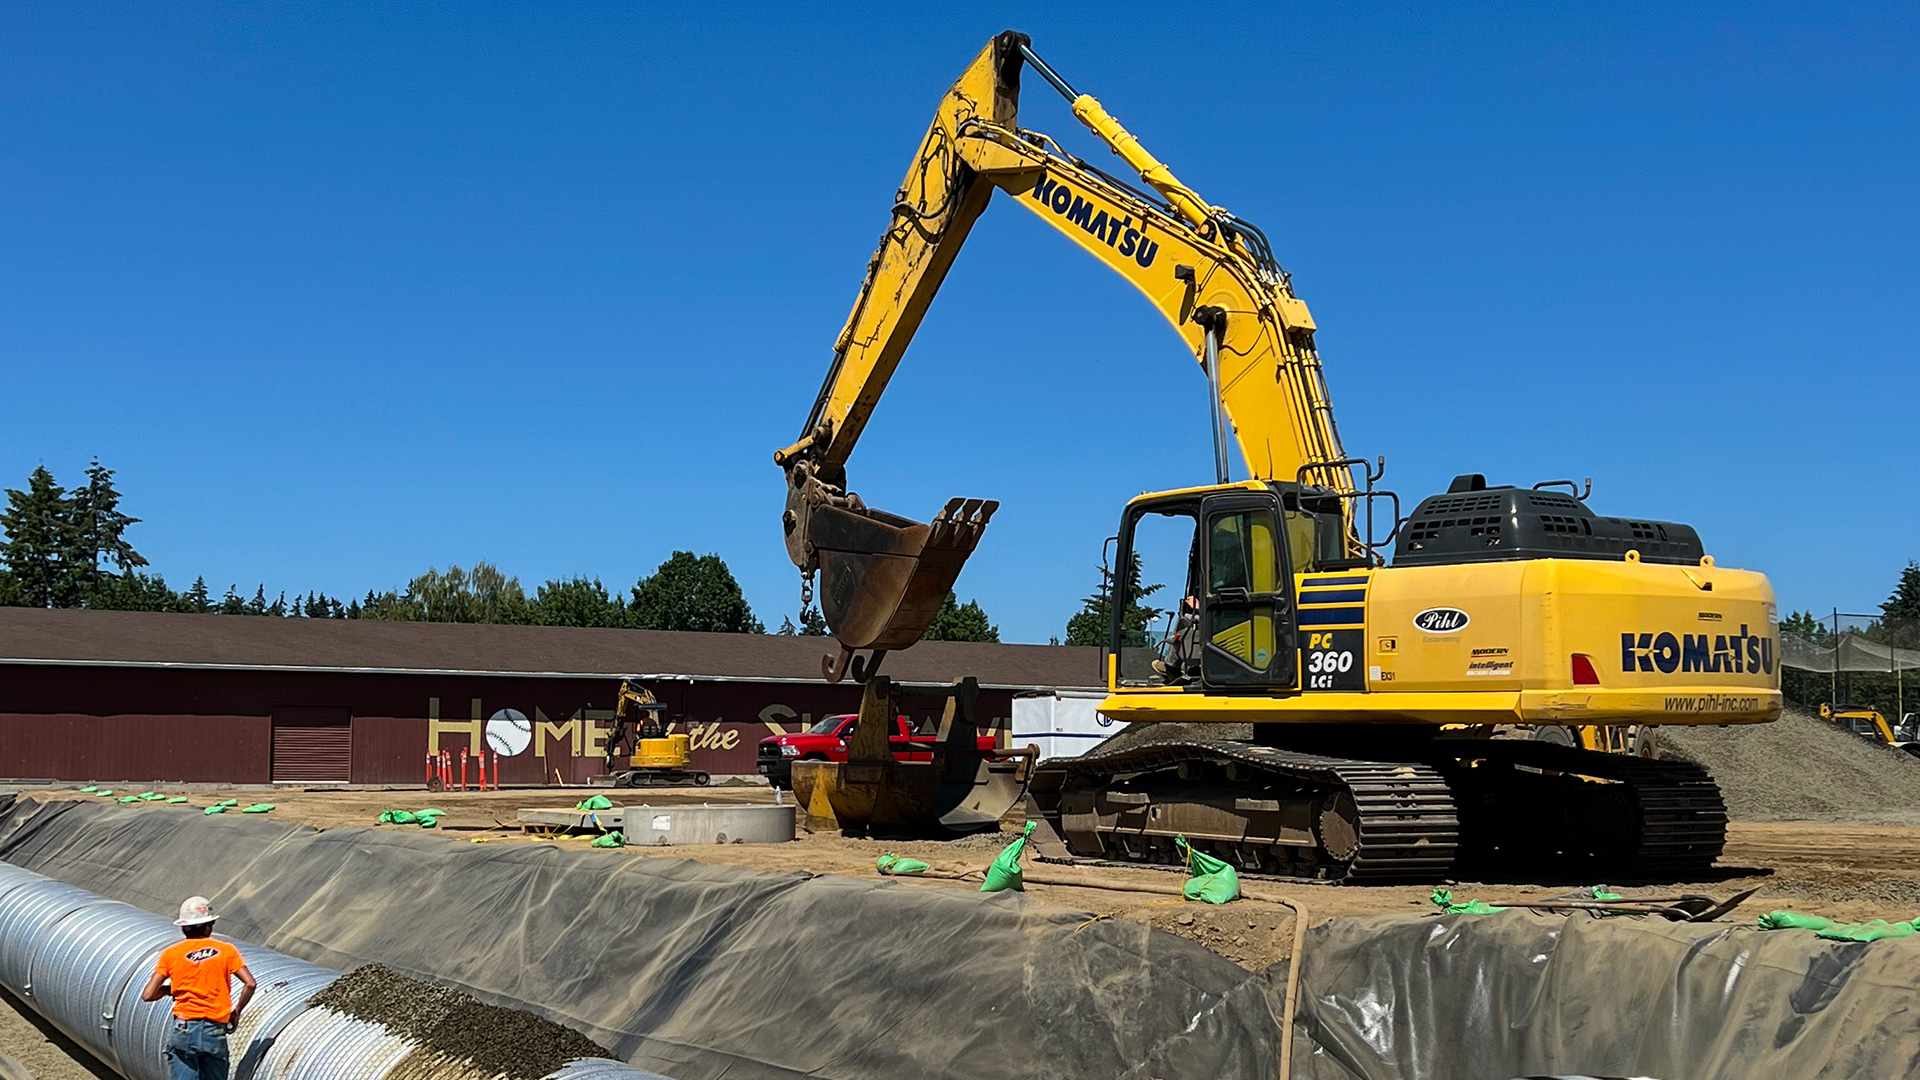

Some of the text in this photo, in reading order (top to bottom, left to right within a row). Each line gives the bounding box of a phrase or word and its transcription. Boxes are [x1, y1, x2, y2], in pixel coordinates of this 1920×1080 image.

[1032, 173, 1160, 268] KOMATSU
[1421, 611, 1461, 630] Pihl
[1309, 633, 1333, 649] PC
[1621, 624, 1773, 675] KOMATSU
[1308, 650, 1353, 673] 360
[1468, 661, 1514, 671] intelligent
[1310, 675, 1333, 688] LCi
[1664, 693, 1759, 714] www.pihl-inc.com
[688, 716, 741, 751] the
